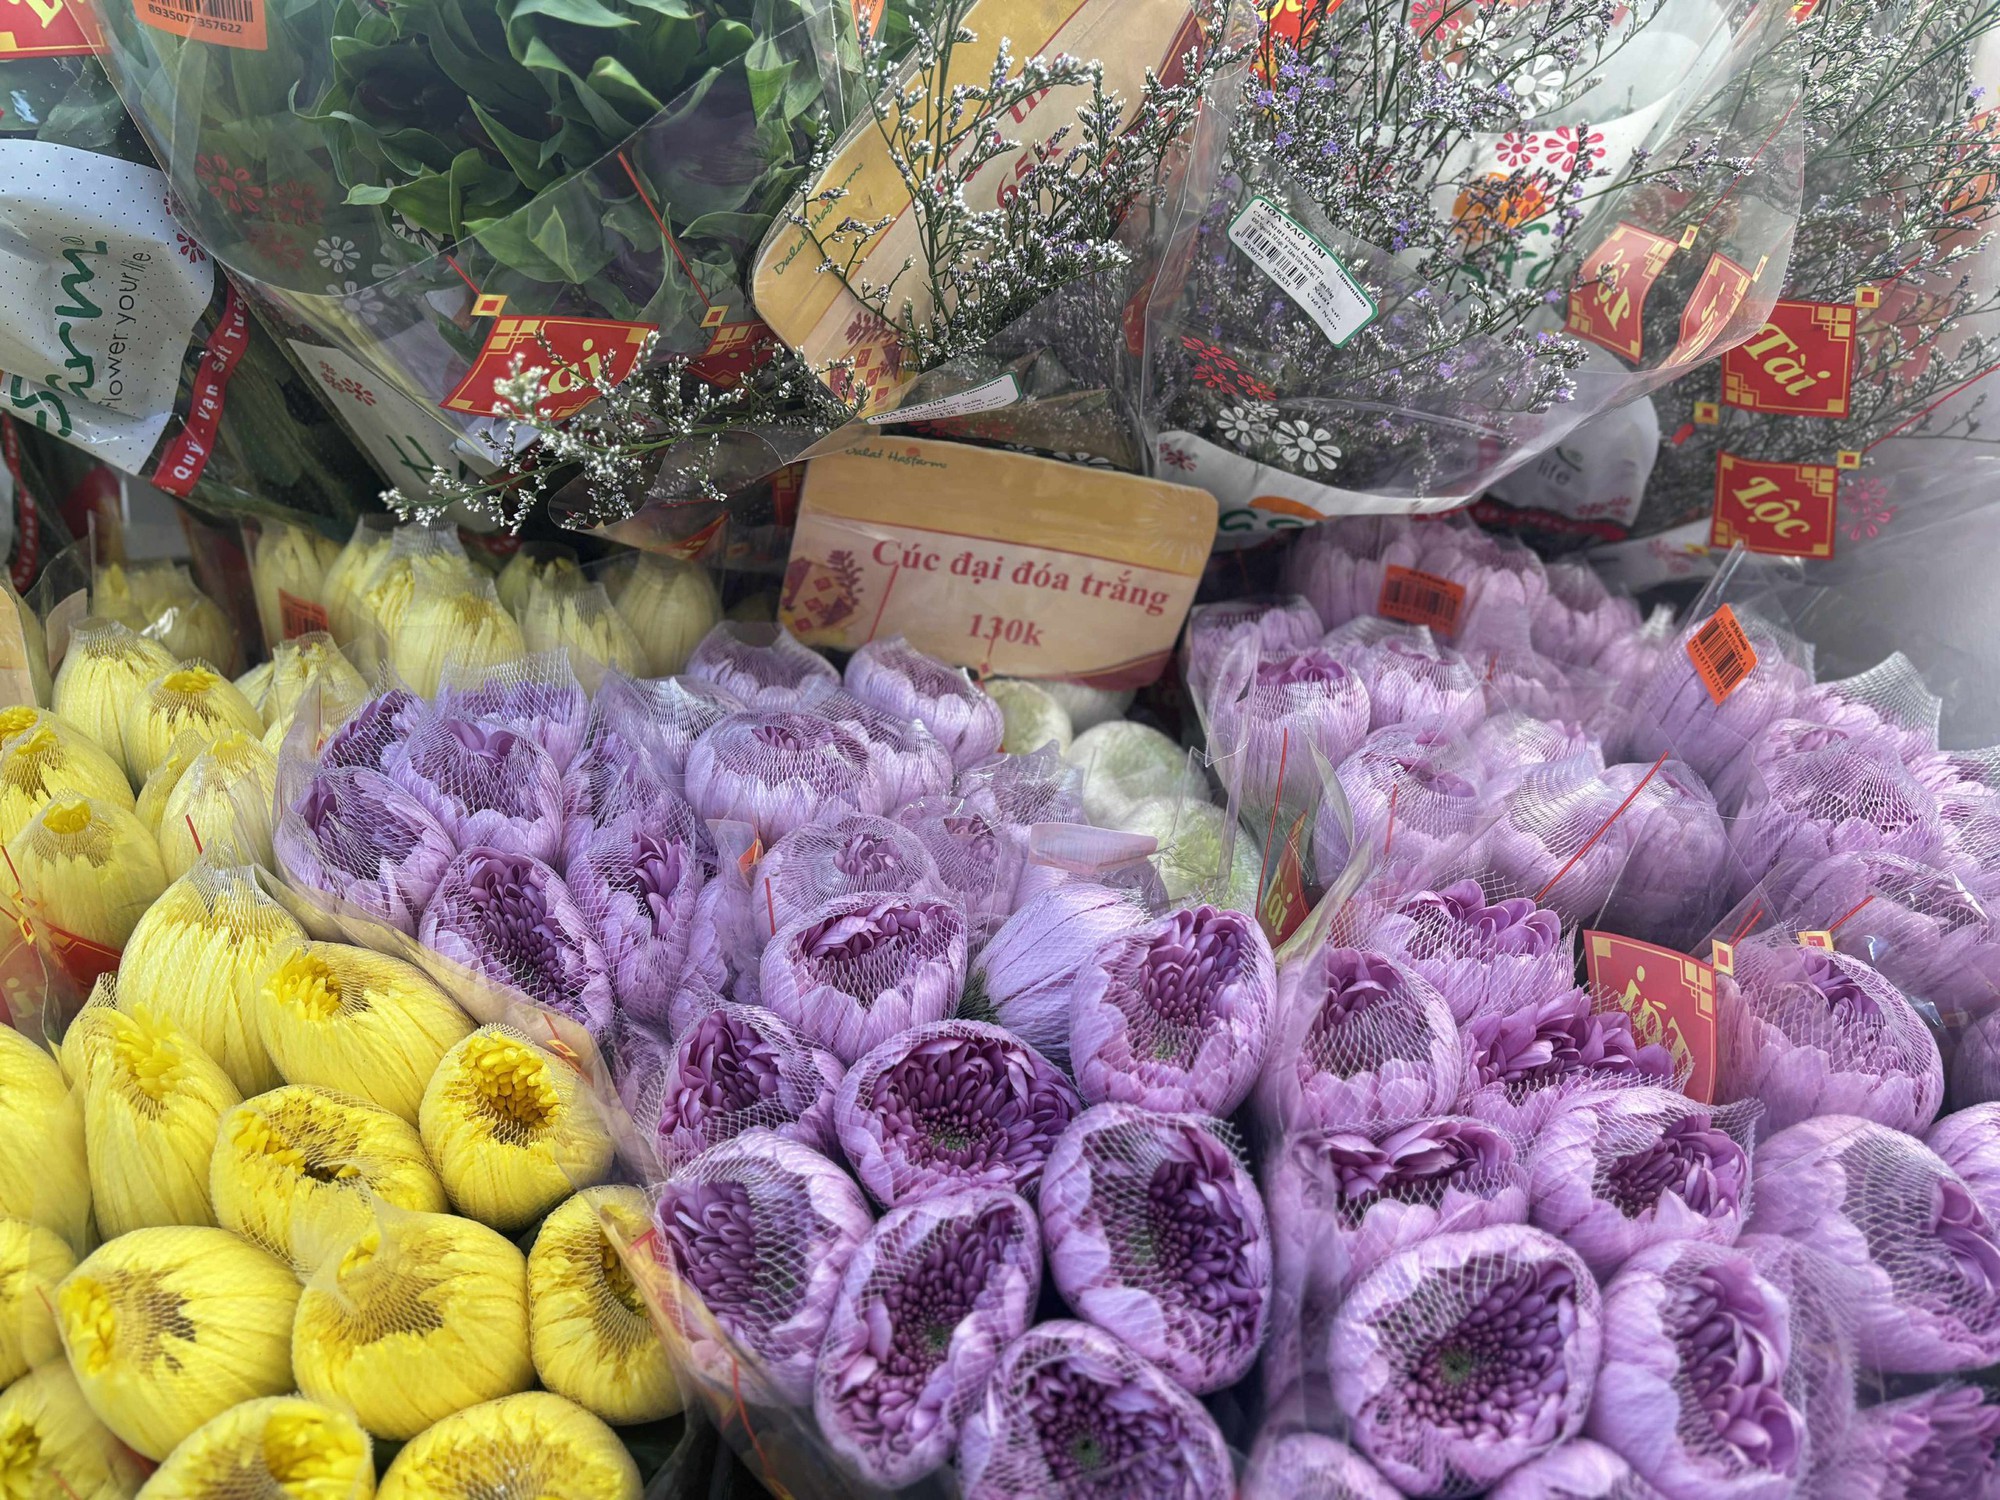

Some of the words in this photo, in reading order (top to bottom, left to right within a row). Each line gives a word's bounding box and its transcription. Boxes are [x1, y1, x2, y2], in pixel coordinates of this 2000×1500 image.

[148, 4, 242, 33] 8935077357622
[1259, 201, 1281, 222] HOA
[1284, 221, 1306, 241] SAO
[1308, 239, 1326, 259] TÍM
[1242, 240, 1264, 261] 935077
[1270, 268, 1292, 287] 376531
[1336, 268, 1366, 308] Limonium
[116, 272, 140, 326] your
[1742, 322, 1831, 396] Tài
[173, 440, 205, 481] Quý
[198, 383, 219, 421] Vạn
[1731, 475, 1811, 538] Lộc
[871, 539, 942, 573] Cúc
[950, 551, 1004, 586] đại
[1011, 560, 1070, 593] đóa
[1081, 568, 1171, 615] trắng
[967, 612, 1044, 647] 130k
